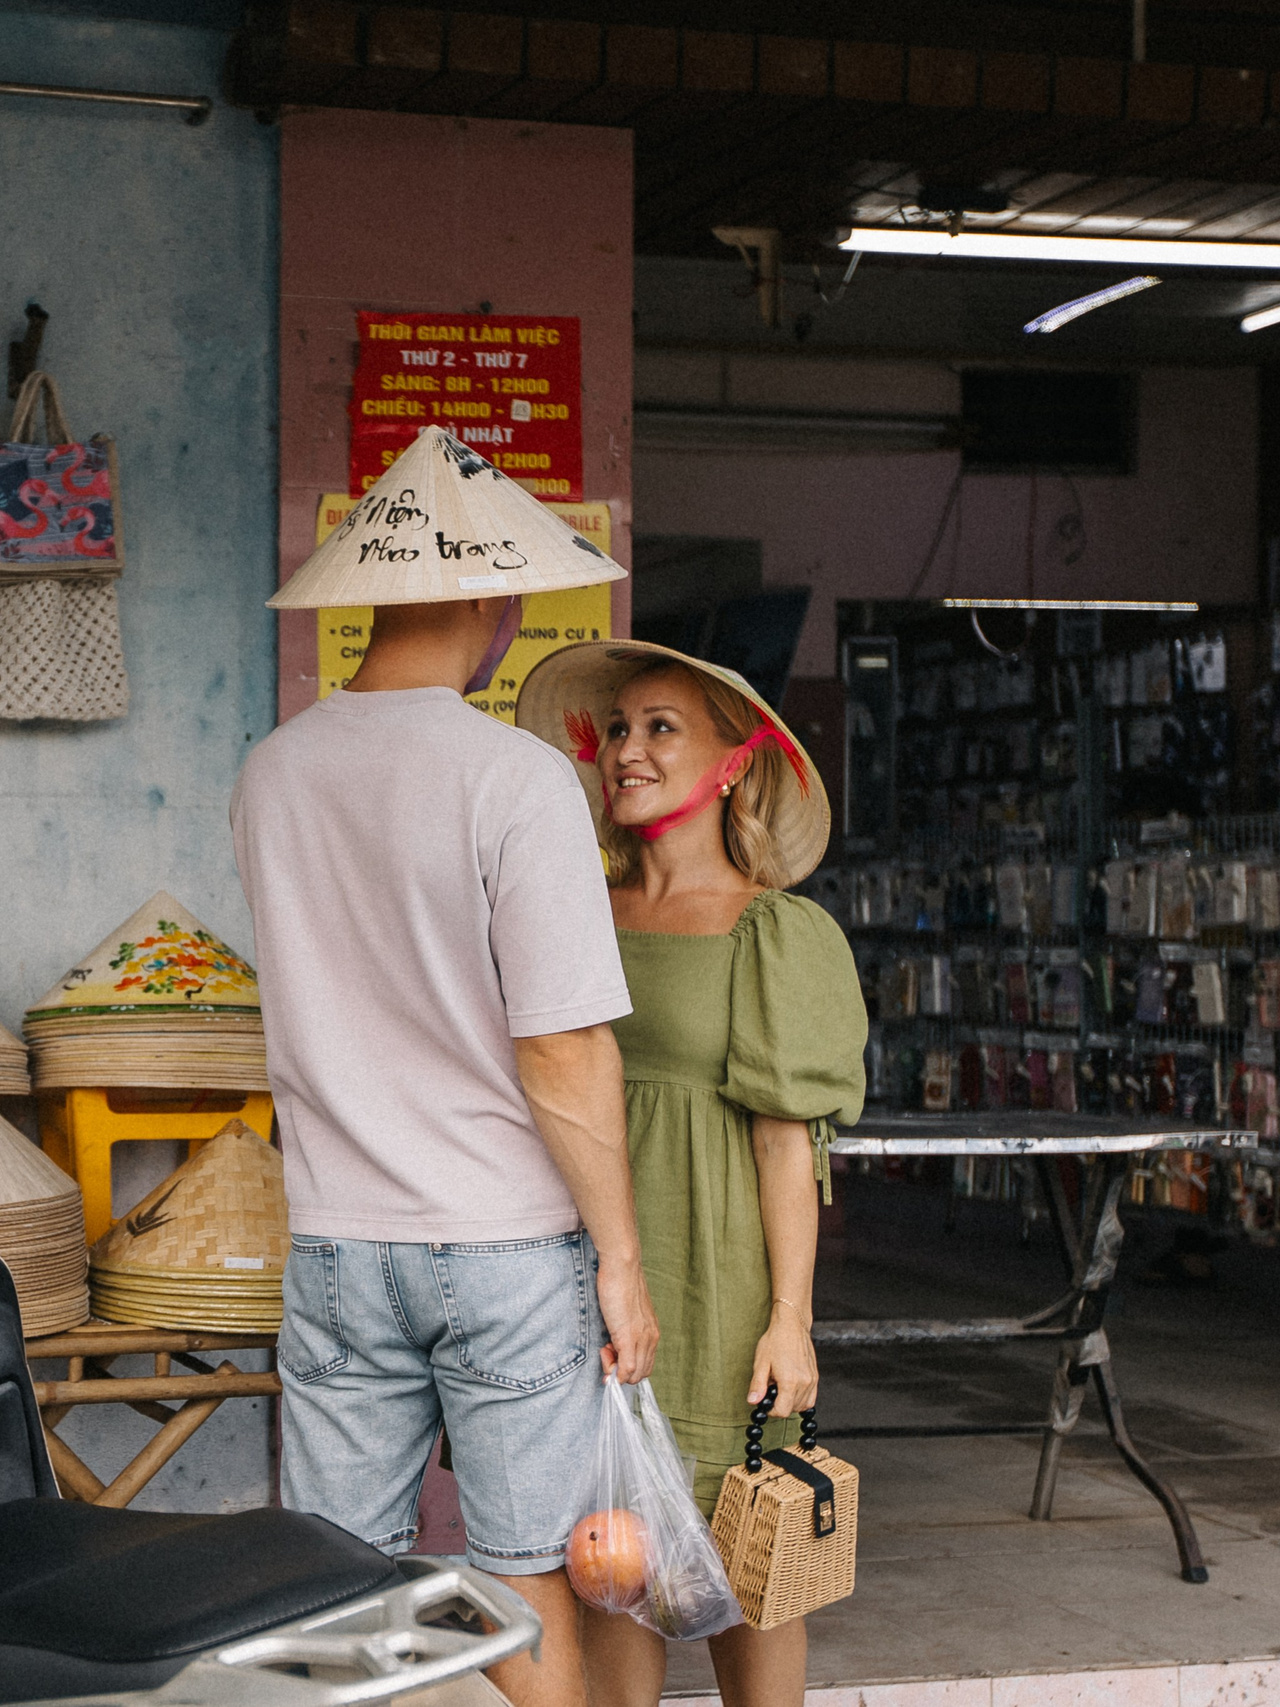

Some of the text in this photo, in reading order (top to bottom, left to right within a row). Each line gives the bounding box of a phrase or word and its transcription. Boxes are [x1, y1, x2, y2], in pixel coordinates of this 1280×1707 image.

[417, 325, 465, 341] GIAN
[469, 324, 512, 343] LÀM
[516, 325, 560, 348] VIỆC
[442, 351, 456, 367] 2
[515, 353, 528, 368] 7
[490, 377, 550, 394] 12H00
[431, 401, 492, 418] 14H00
[463, 424, 514, 447] NHẬT
[490, 453, 551, 470] 12H00
[516, 627, 558, 640] HUNG
